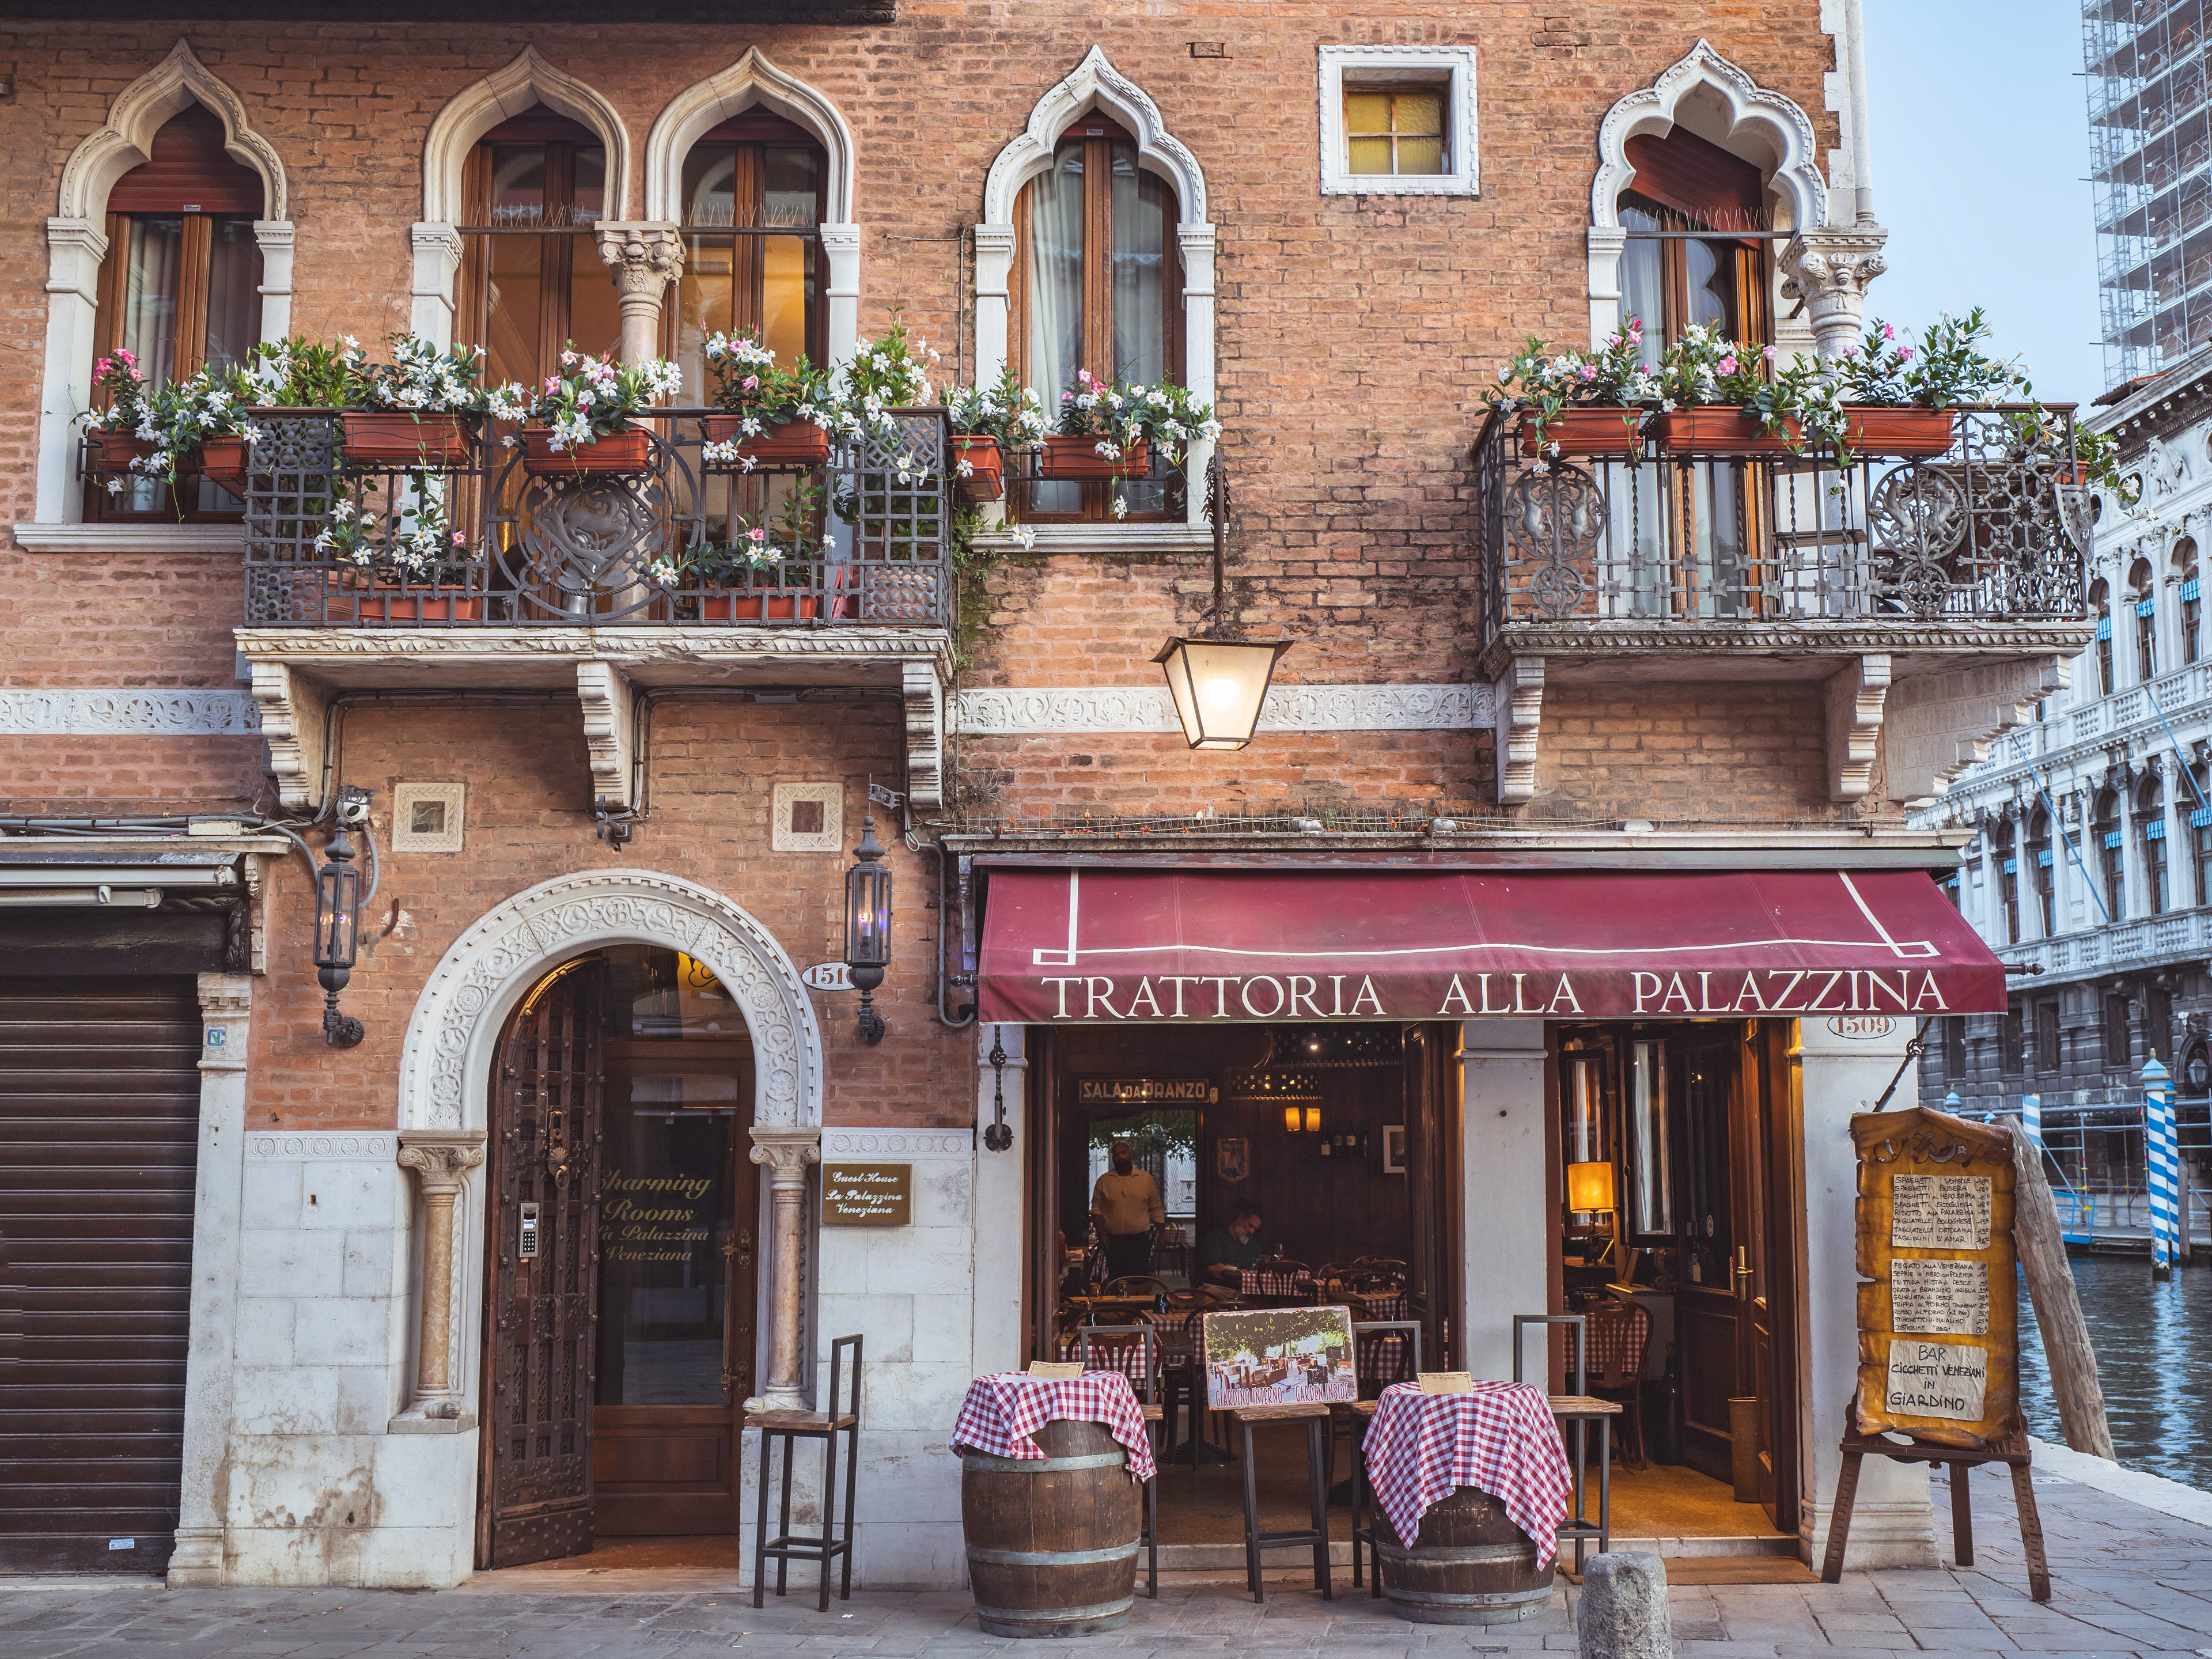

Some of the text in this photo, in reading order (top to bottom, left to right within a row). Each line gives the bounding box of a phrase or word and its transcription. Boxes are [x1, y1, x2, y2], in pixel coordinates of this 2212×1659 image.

[1041, 969, 1950, 1018] TRATTORIA ALLA PALAZZINA
[1837, 1017, 1890, 1033] 1509
[1084, 1082, 1122, 1098] SALA
[1125, 1086, 1141, 1098] DA
[833, 1172, 900, 1183] Guest House
[825, 1190, 906, 1205] La Palazzina
[602, 1199, 698, 1221] Rooms
[836, 1203, 895, 1218] Veneziana
[619, 1225, 709, 1240] Palazzina
[1976, 1236, 1990, 1244] 16€
[607, 1245, 693, 1260] Veneziana
[1919, 1345, 1945, 1362] BAR
[1215, 1386, 1283, 1407] GIARDINO INTERNO
[1296, 1382, 1349, 1402] GARDEN INSIDE
